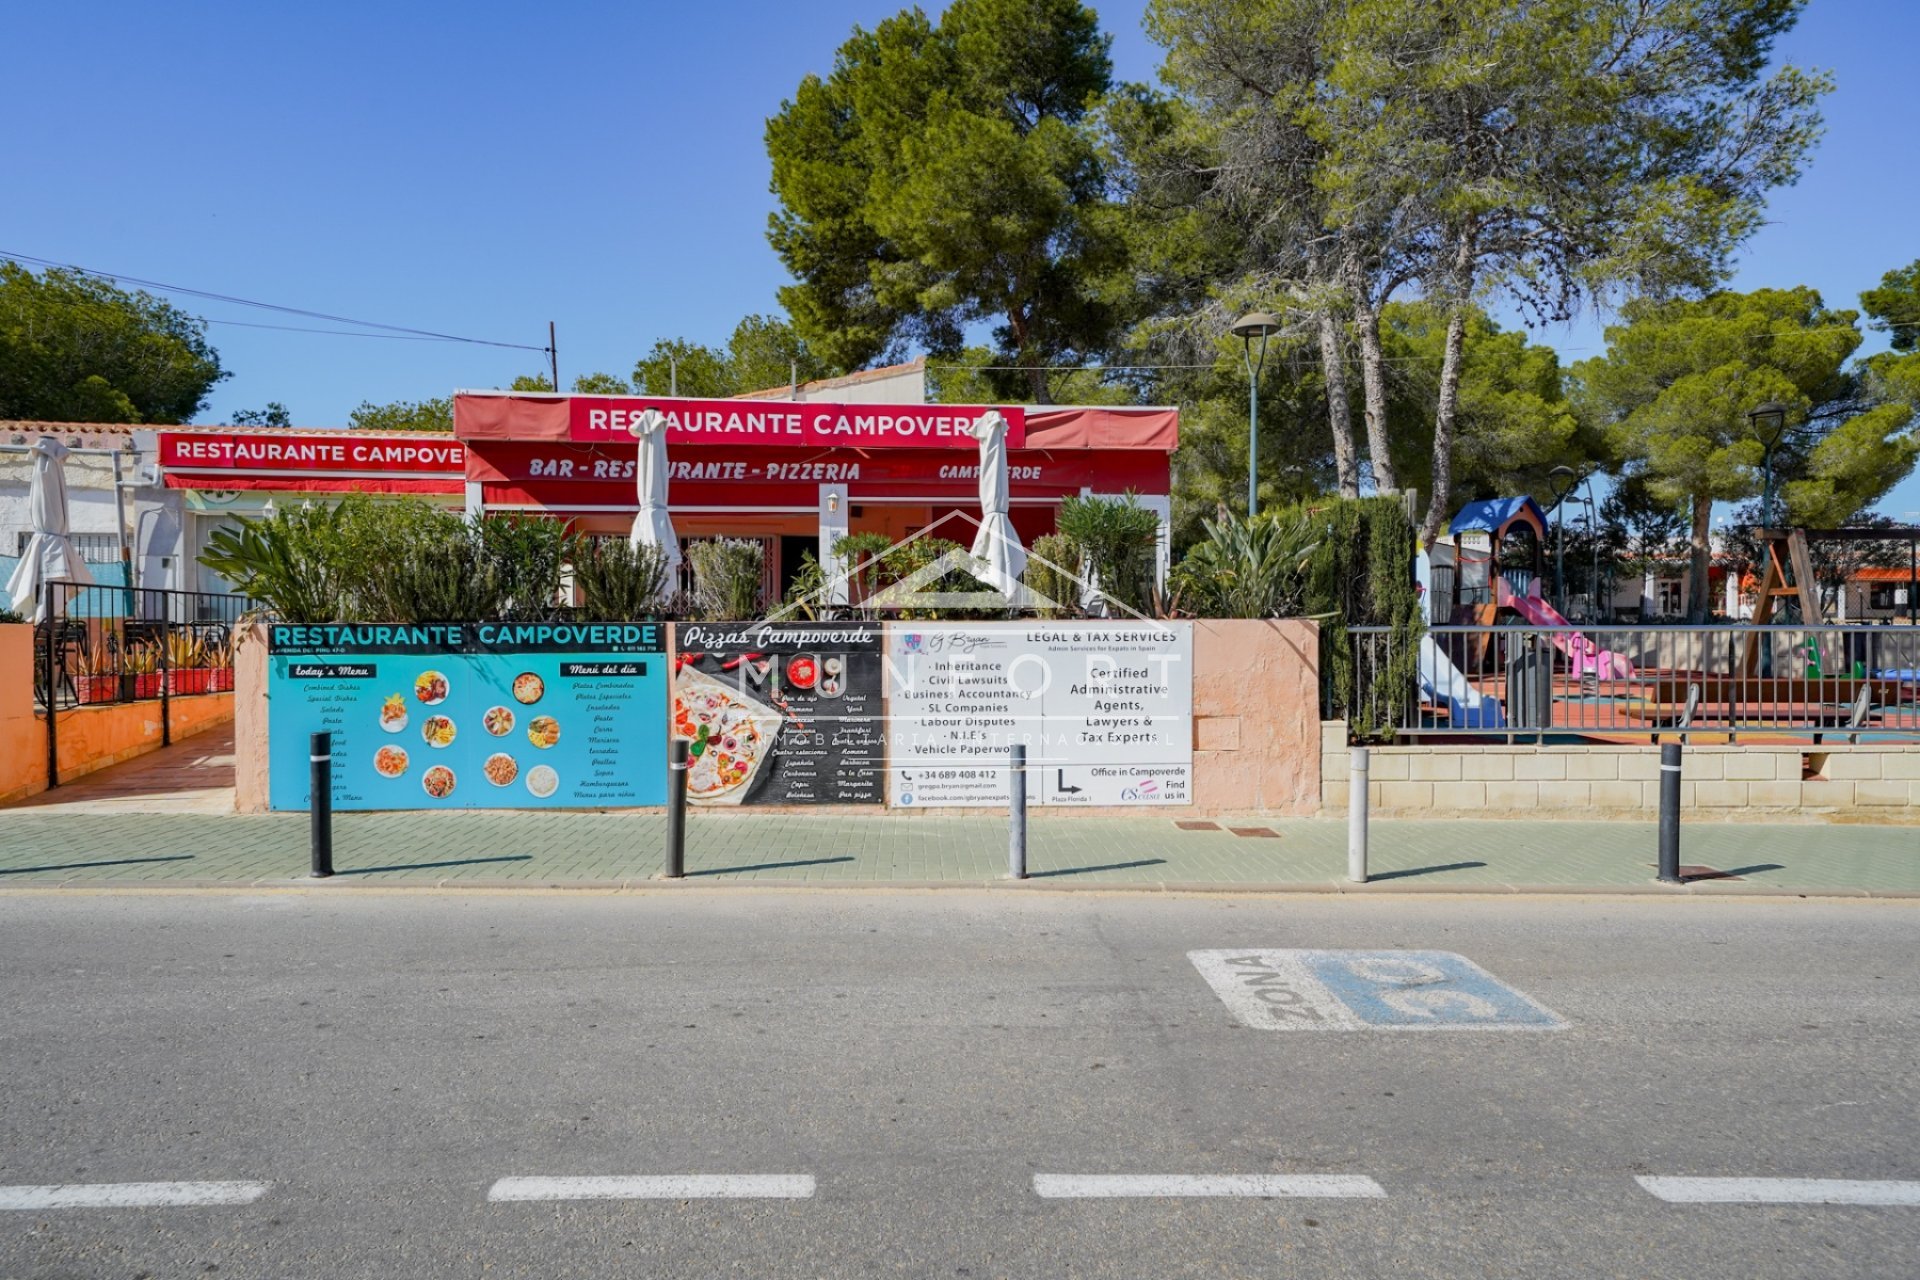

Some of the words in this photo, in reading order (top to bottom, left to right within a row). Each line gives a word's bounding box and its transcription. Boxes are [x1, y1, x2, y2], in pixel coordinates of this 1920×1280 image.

[590, 409, 802, 434] RESAURANTE
[814, 415, 1008, 436] CAMPOVER
[176, 441, 345, 461] RESTAURANTE
[353, 446, 463, 464] CAMPOVE
[529, 459, 574, 477] BAR
[594, 460, 747, 480] RESURANTE
[767, 463, 860, 480] PIZZERIA
[939, 465, 1042, 480] CAMPERDE
[275, 626, 462, 645] RESTAURANTE
[479, 625, 657, 644] CAMPOVERDE
[684, 626, 750, 649] Pizzas
[756, 625, 874, 649] Campoverde
[1026, 632, 1068, 642] LEGAL
[1072, 632, 1082, 642] &
[1086, 632, 1110, 642] TAX
[1115, 631, 1177, 642] SERVICES
[948, 632, 996, 654] Bryan
[338, 666, 369, 675] Menu
[569, 664, 600, 674] Menú
[602, 664, 618, 674] del
[620, 664, 638, 674] día
[935, 661, 1002, 671] Inheritance
[1090, 667, 1149, 679] Certified
[958, 675, 1008, 685] Lawsuits
[1070, 684, 1168, 695] Administrative
[797, 694, 805, 702] de
[928, 703, 941, 713] SL
[945, 703, 1009, 714] Companies
[1094, 700, 1144, 713] Agents,
[921, 717, 962, 727] Labour
[965, 717, 1016, 727] Disputes
[1086, 716, 1139, 729] Lawyers
[1143, 715, 1153, 726] &
[1082, 732, 1103, 742] Tax
[1108, 732, 1157, 744] Experts
[914, 744, 956, 754] Vehicle
[960, 744, 1010, 756] Paperwo
[918, 770, 936, 779] +34
[938, 770, 956, 779] 689
[959, 770, 976, 779] 408
[979, 770, 997, 779] 412
[1091, 767, 1117, 777] Office
[1119, 767, 1128, 776] in
[1129, 767, 1186, 777] Campoverde
[1166, 780, 1185, 789] Find
[1176, 790, 1185, 799] in
[1225, 955, 1325, 1021] ZONA
